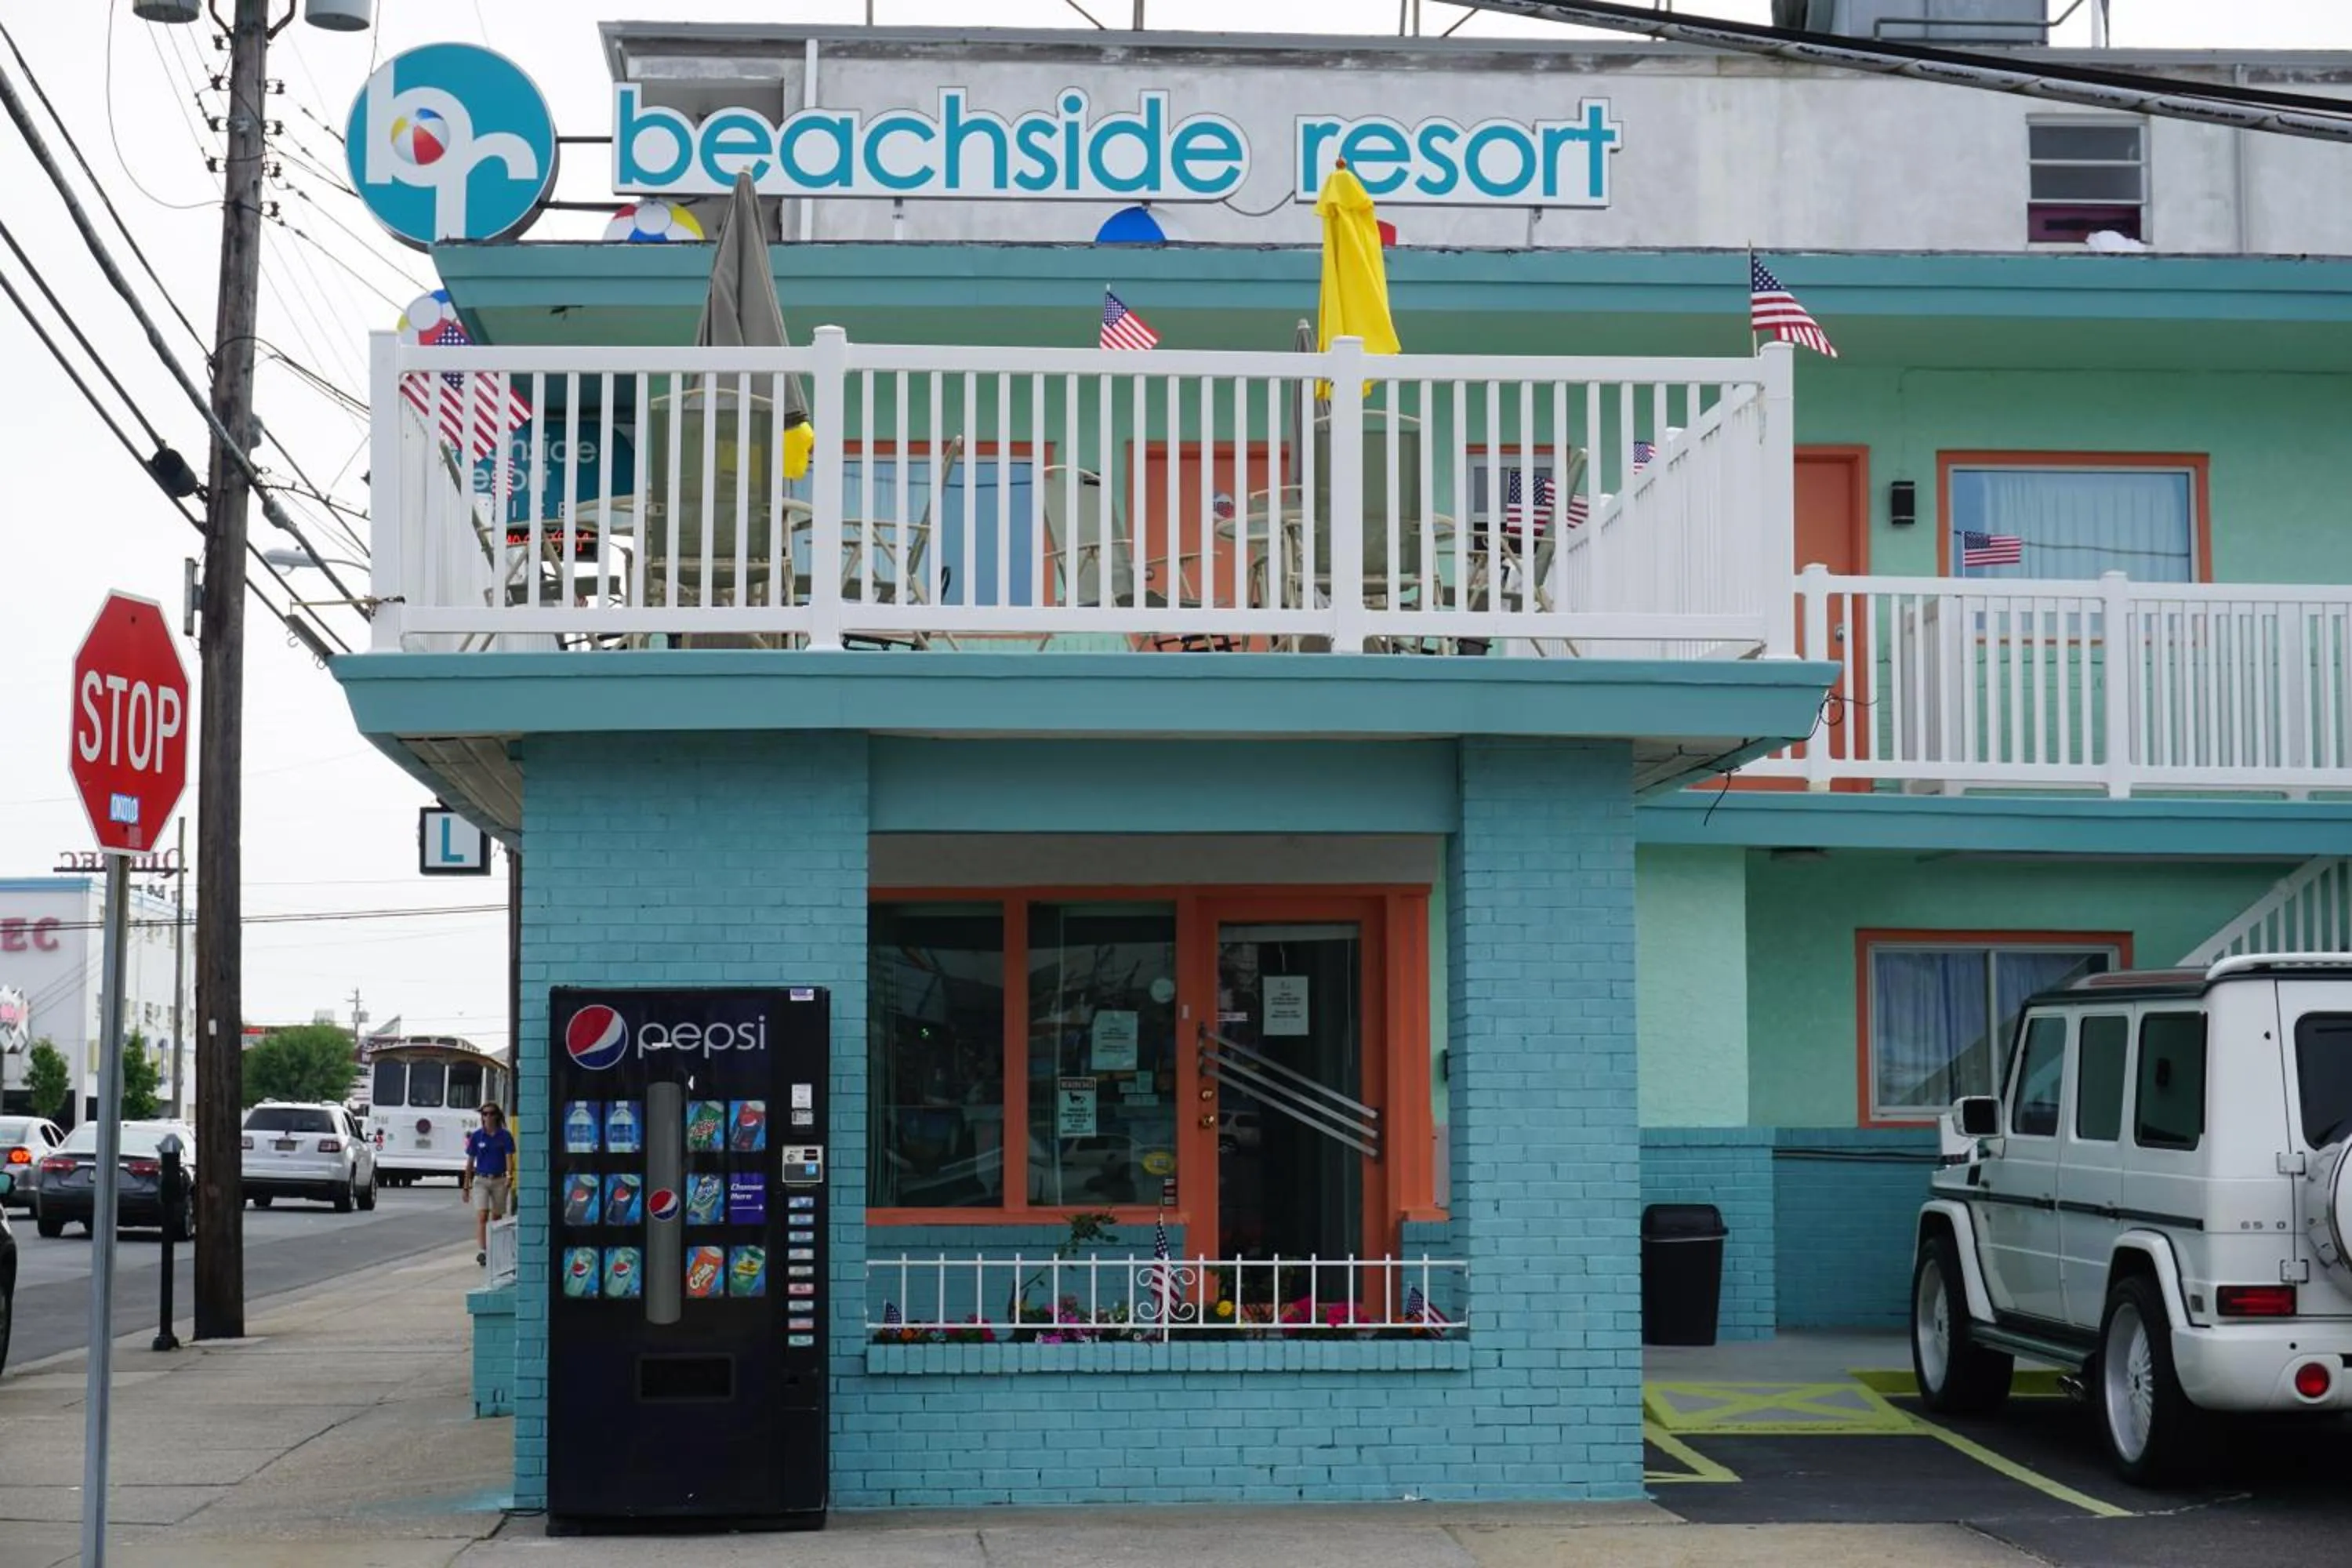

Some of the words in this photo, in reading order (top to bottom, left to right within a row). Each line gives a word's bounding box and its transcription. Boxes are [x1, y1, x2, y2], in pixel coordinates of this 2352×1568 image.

[619, 89, 1243, 194] beachside
[1303, 105, 1617, 198] resort
[79, 669, 181, 774] STOP
[441, 817, 465, 863] L
[638, 1015, 766, 1059] pepsi
